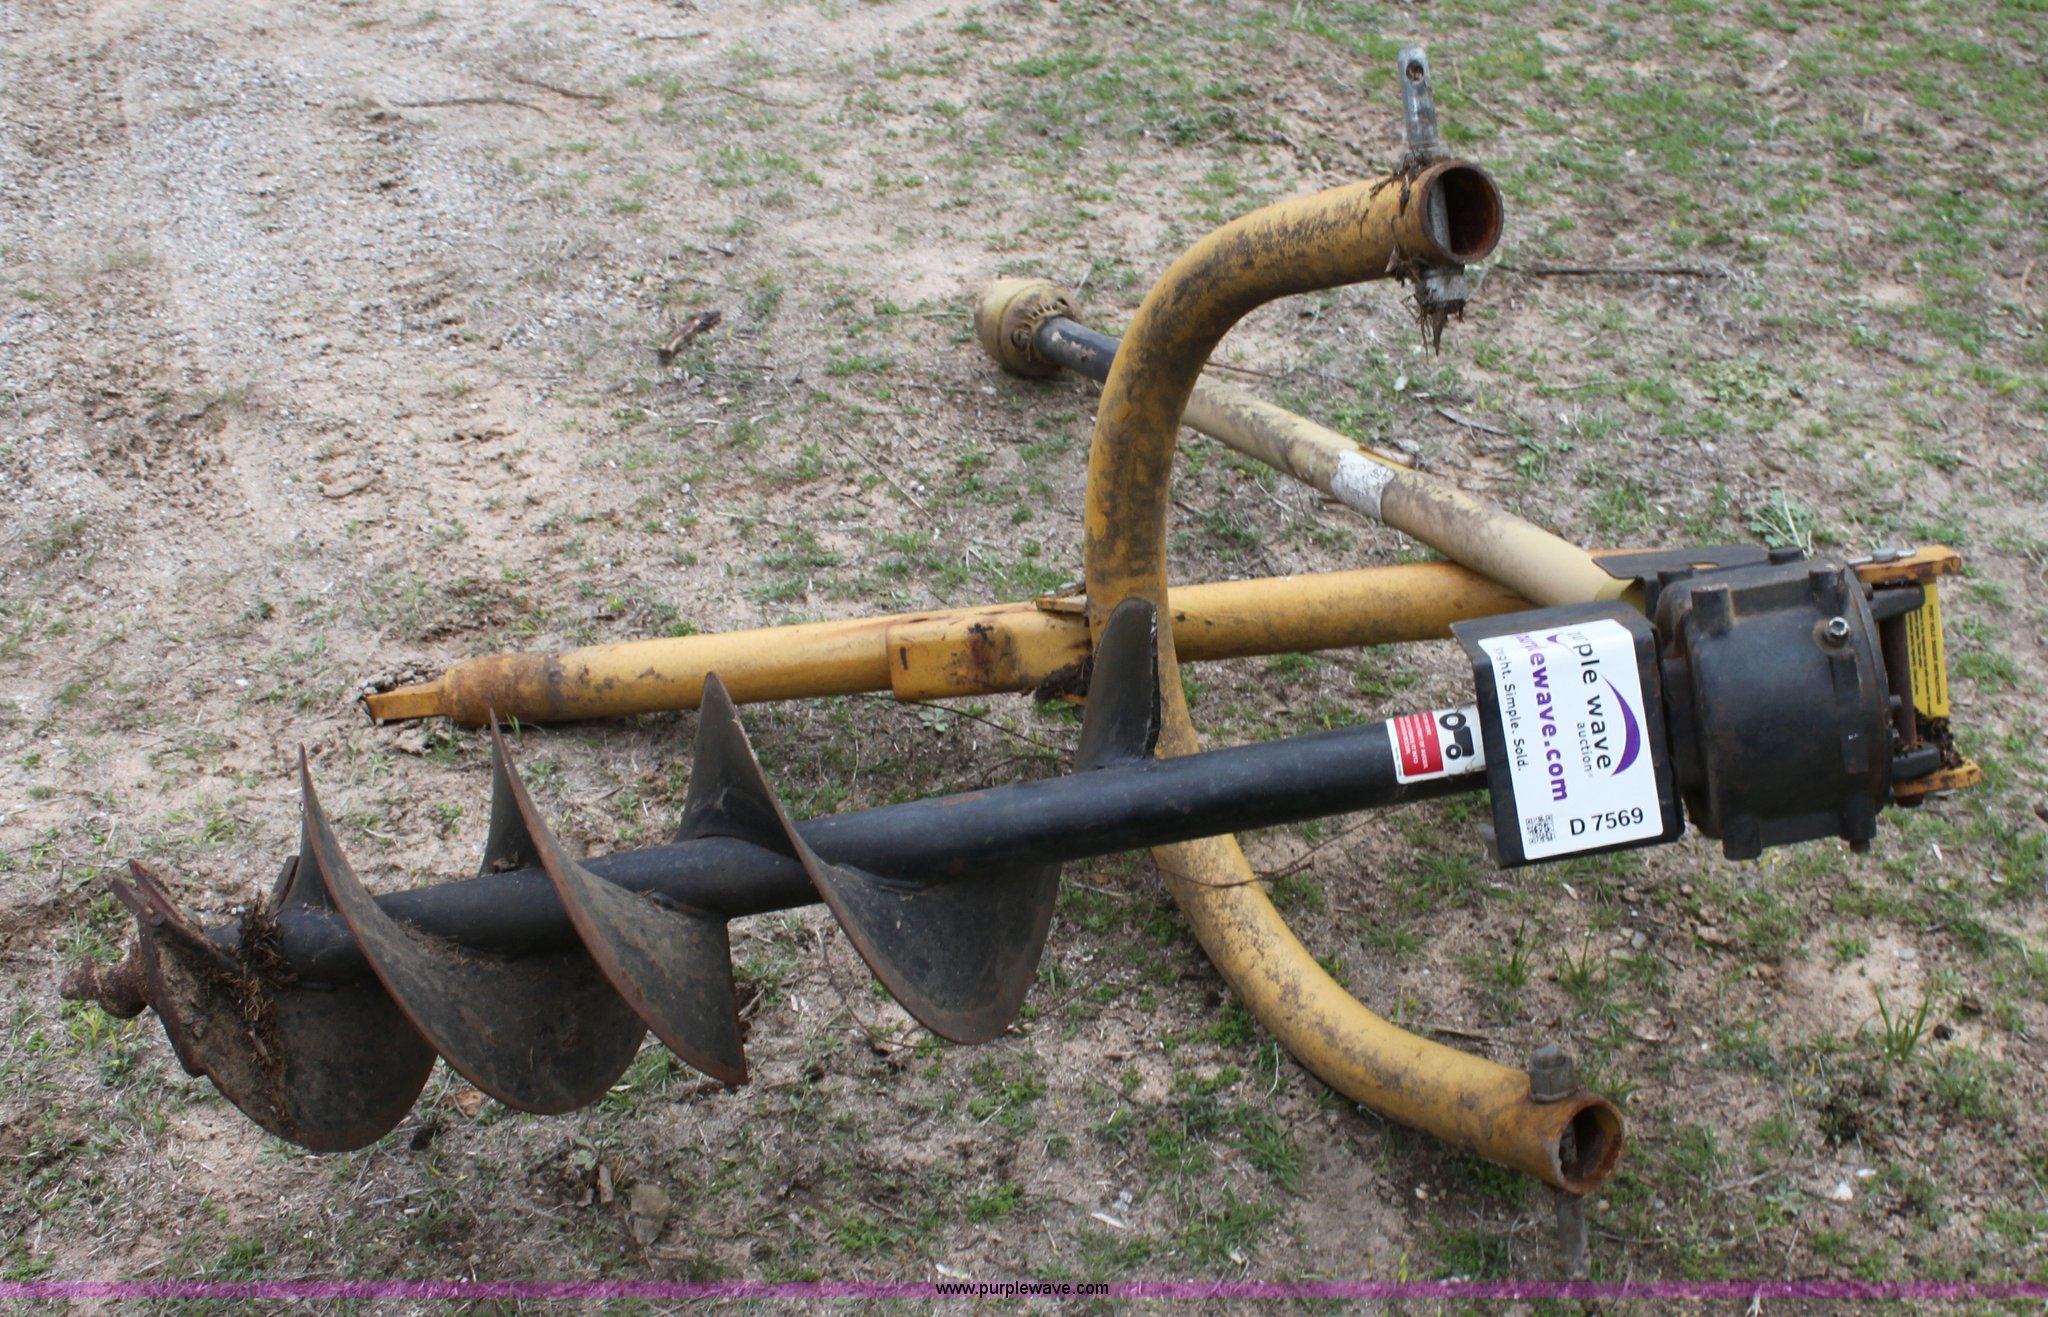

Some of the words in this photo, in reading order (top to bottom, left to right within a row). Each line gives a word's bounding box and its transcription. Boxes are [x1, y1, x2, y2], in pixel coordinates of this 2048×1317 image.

[1504, 684, 1519, 734] Simple.
[1513, 738, 1528, 772] Sold.
[1577, 722, 1592, 773] auction
[1586, 694, 1612, 770] wave
[1569, 817, 1586, 836] D
[1591, 807, 1645, 832] 7569
